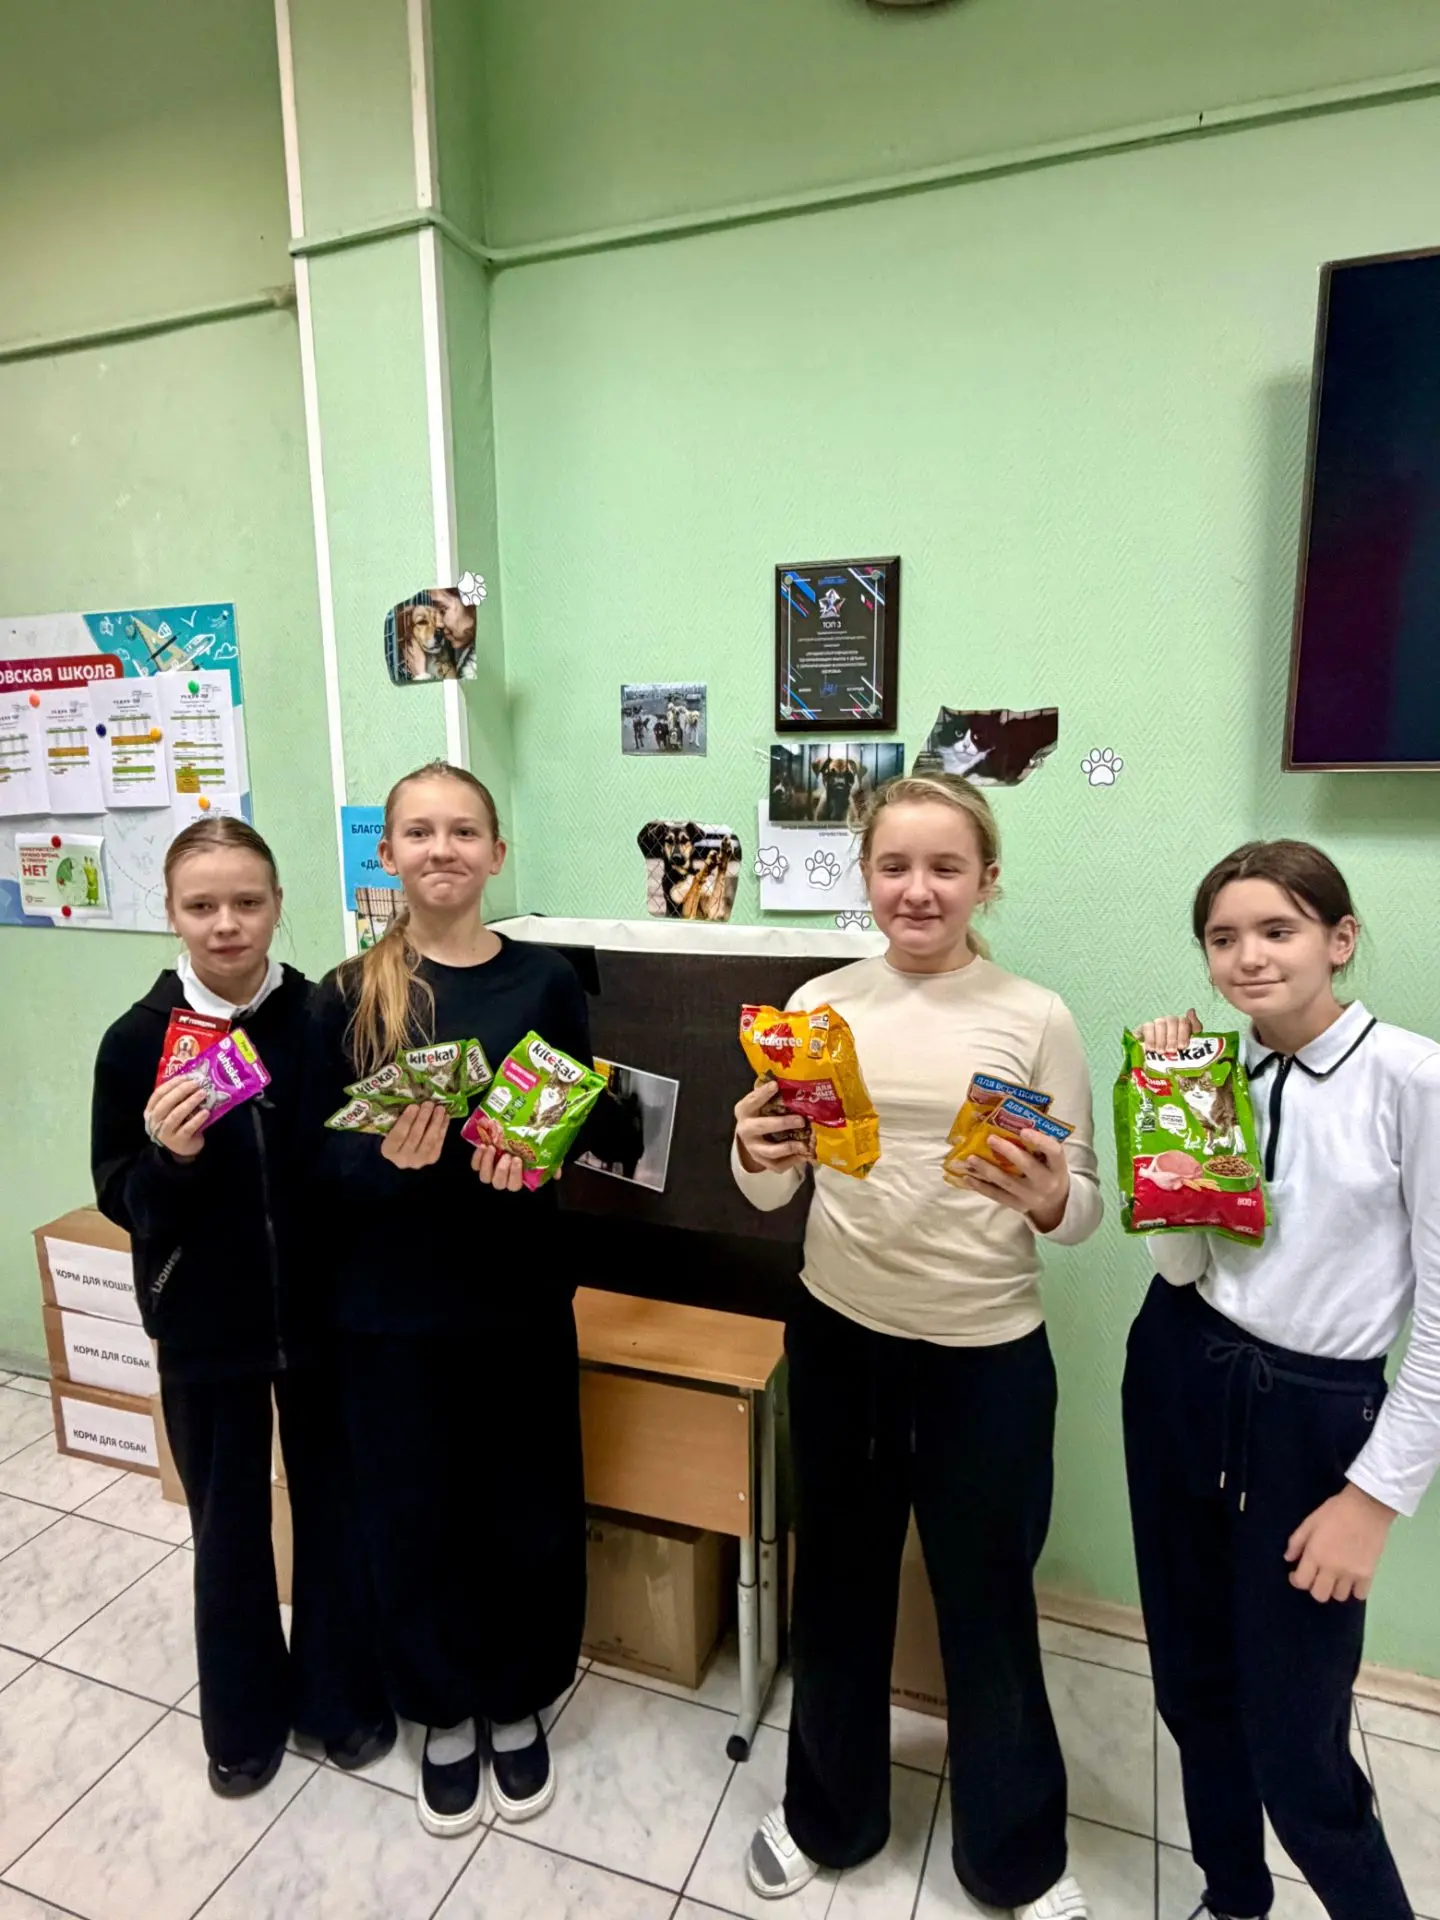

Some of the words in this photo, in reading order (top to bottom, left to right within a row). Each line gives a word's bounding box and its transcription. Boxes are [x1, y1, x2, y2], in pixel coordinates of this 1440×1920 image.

[57, 663, 115, 681] школа
[22, 864, 48, 877] НЕТ
[361, 859, 383, 871] «ДА
[753, 1030, 803, 1050] Pedigree
[409, 1048, 454, 1065] kitekat
[467, 1049, 487, 1081] kitekat
[532, 1043, 576, 1080] kitekat
[217, 1050, 244, 1089] whiskas
[356, 1067, 397, 1096] kitekat
[335, 1102, 367, 1128] kitekat
[56, 1268, 80, 1281] КОРМ
[82, 1275, 100, 1286] ДЛЯ
[102, 1279, 134, 1293] КОШЕК
[73, 1344, 99, 1357] КОРМ
[101, 1350, 119, 1361] ДЛЯ
[121, 1355, 150, 1368] СОБАК
[73, 1429, 98, 1442] КОРМ
[99, 1435, 117, 1447] ДЛЯ
[118, 1440, 147, 1453] СОБАК
